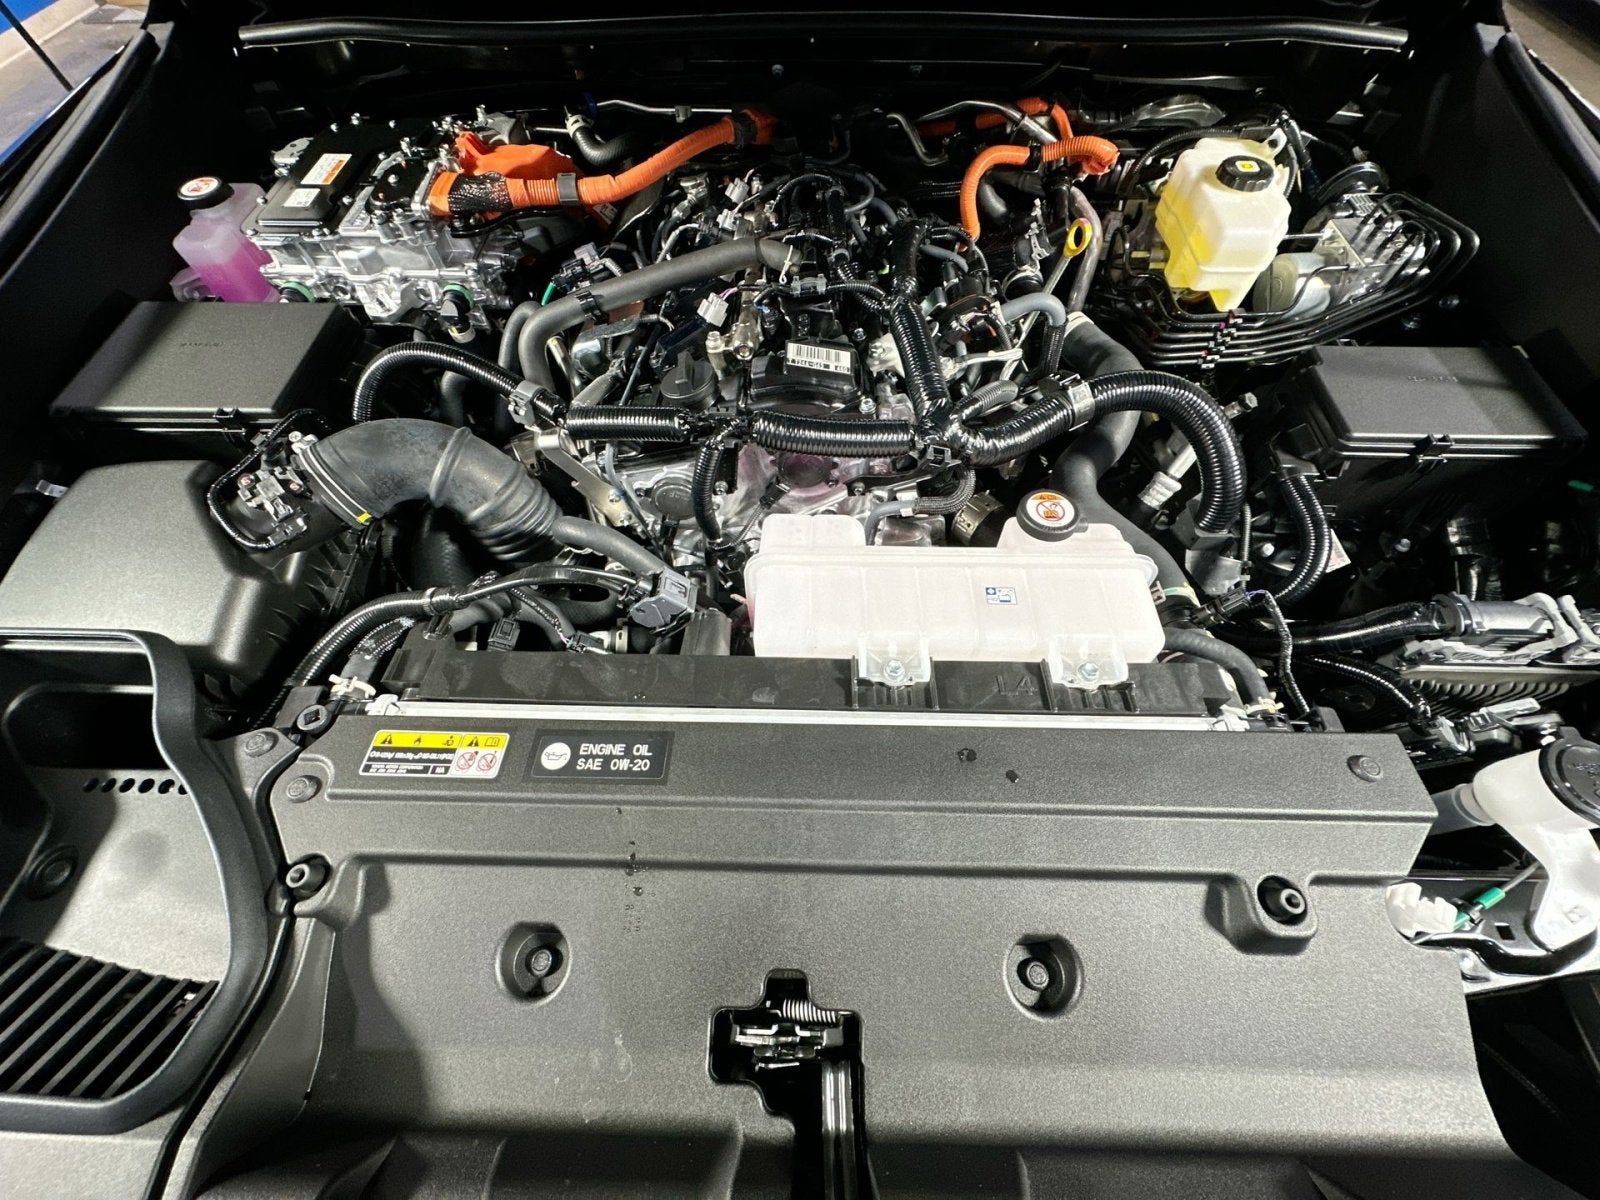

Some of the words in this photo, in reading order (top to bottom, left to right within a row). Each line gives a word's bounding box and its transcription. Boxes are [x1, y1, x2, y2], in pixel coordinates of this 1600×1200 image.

[579, 743, 626, 756] ENGINE
[633, 744, 653, 756] OIL
[576, 758, 603, 771] SAE
[610, 758, 650, 771] 0W-20
